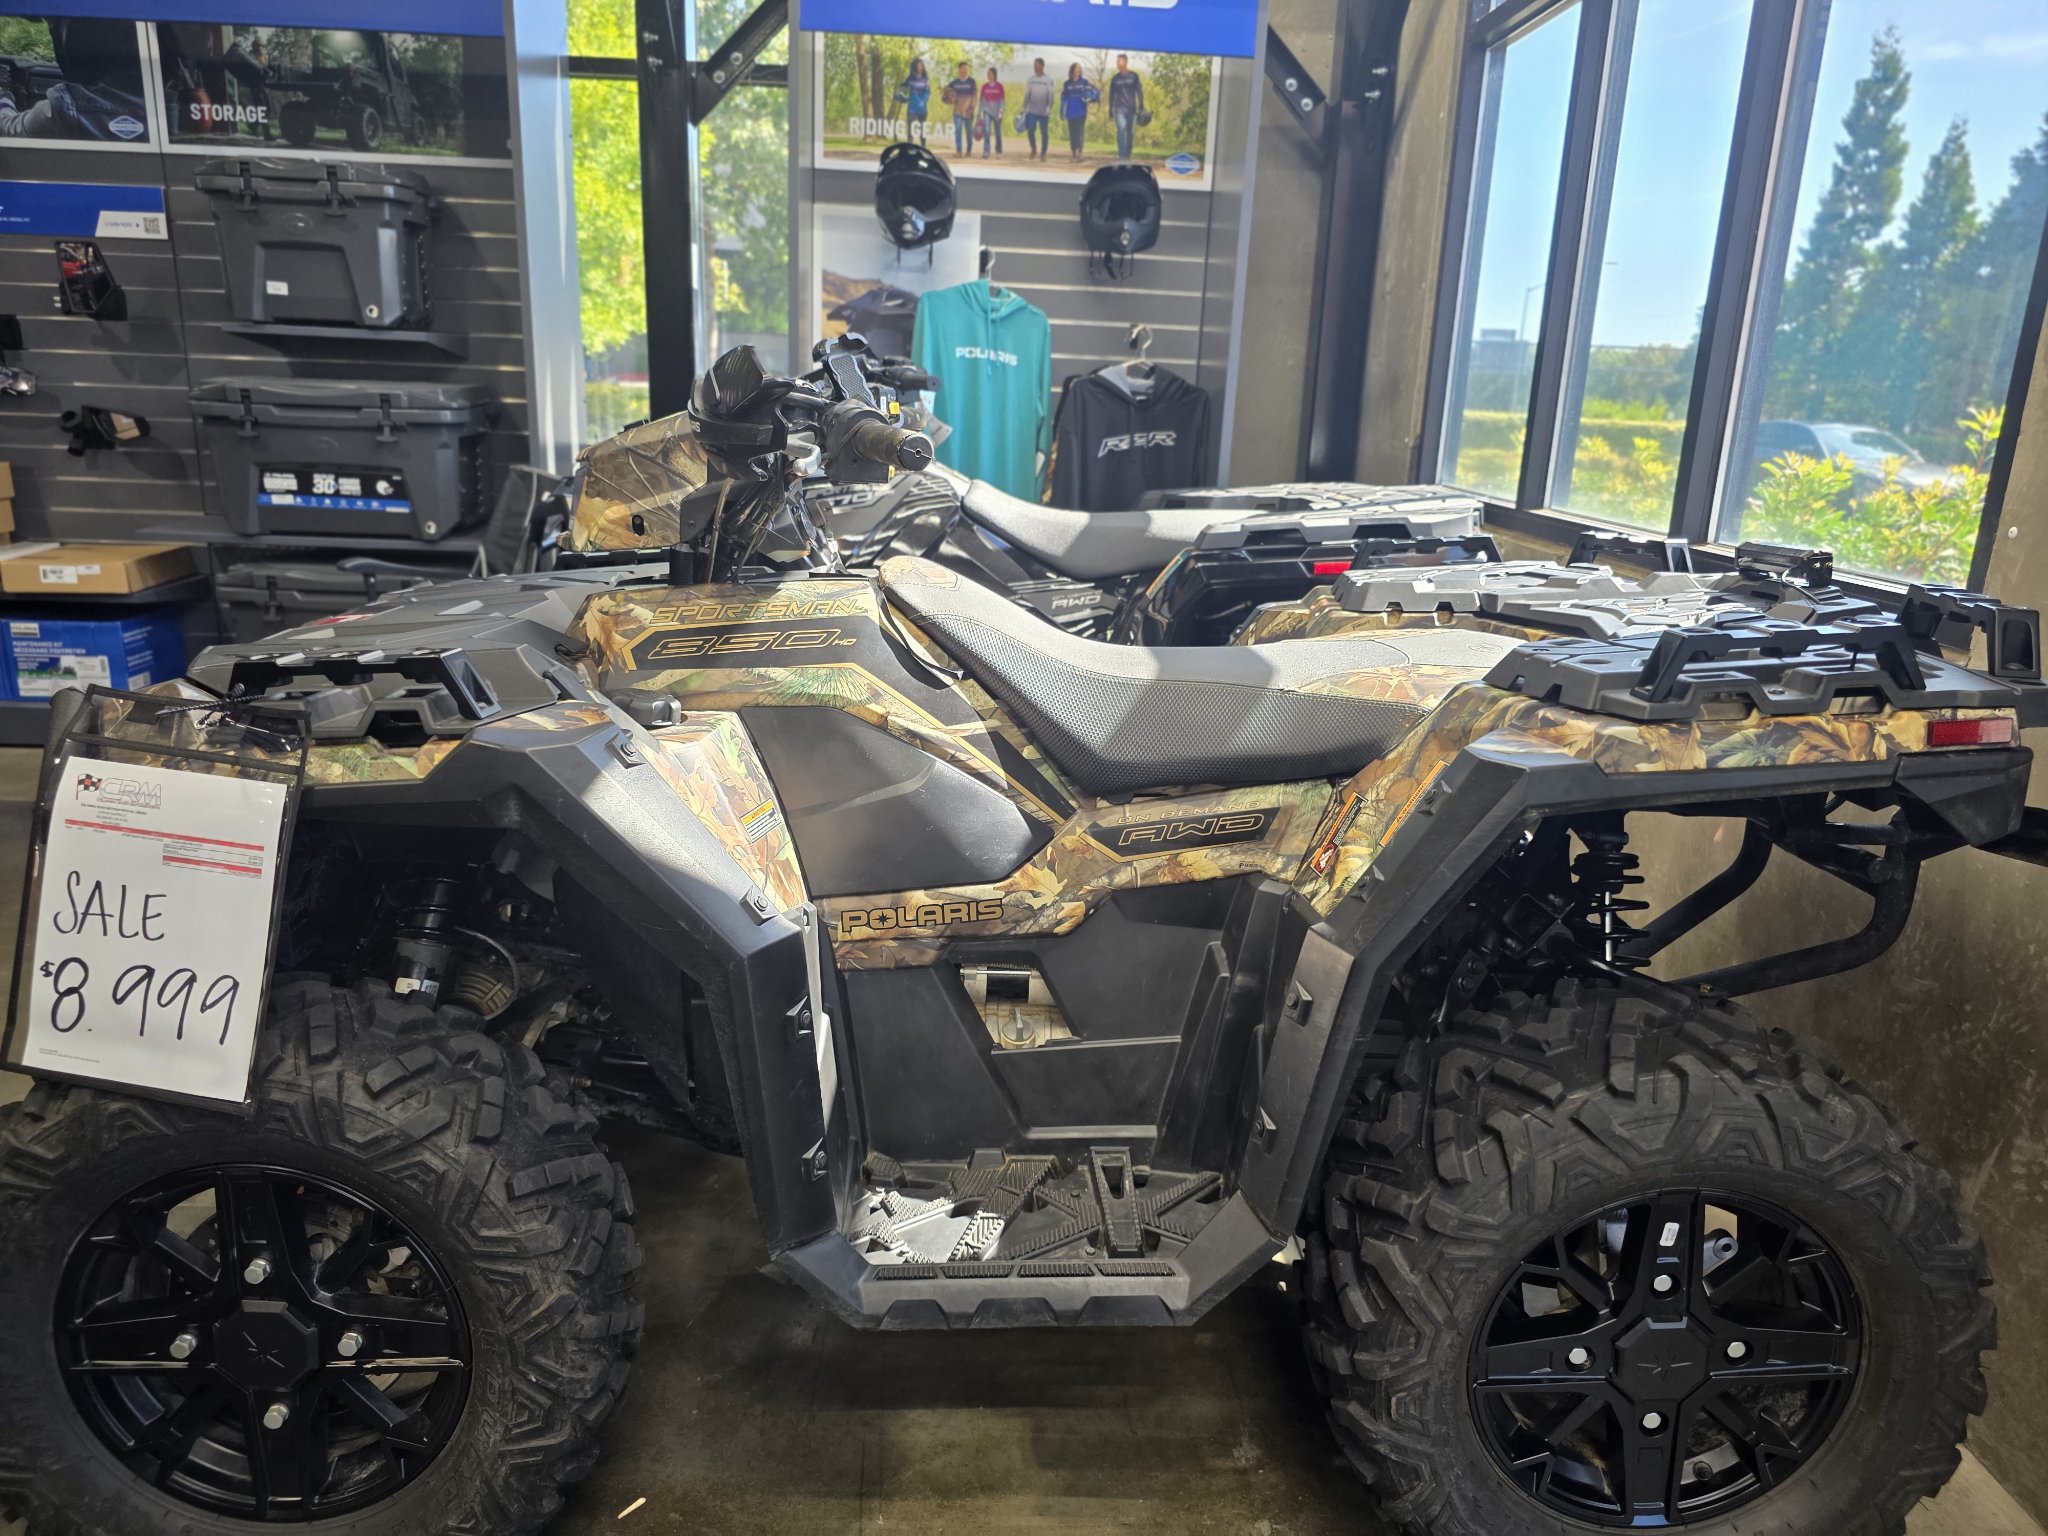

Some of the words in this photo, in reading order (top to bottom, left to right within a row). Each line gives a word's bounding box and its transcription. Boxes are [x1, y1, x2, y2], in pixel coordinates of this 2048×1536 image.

[190, 103, 268, 124] STORAGE
[849, 117, 905, 137] RIDING
[911, 121, 955, 139] GEAR
[955, 346, 1018, 366] POLARIS
[1098, 431, 1177, 458] RZR
[649, 600, 858, 624] SPORTSMAN
[1051, 594, 1102, 610] AWD
[647, 629, 842, 659] 850
[99, 777, 162, 806] CRM
[1117, 814, 1151, 824] ON
[1160, 800, 1262, 820] DEMAND
[1118, 813, 1265, 846] AWD
[53, 870, 168, 941] SALE
[841, 898, 1004, 933] POLARIS
